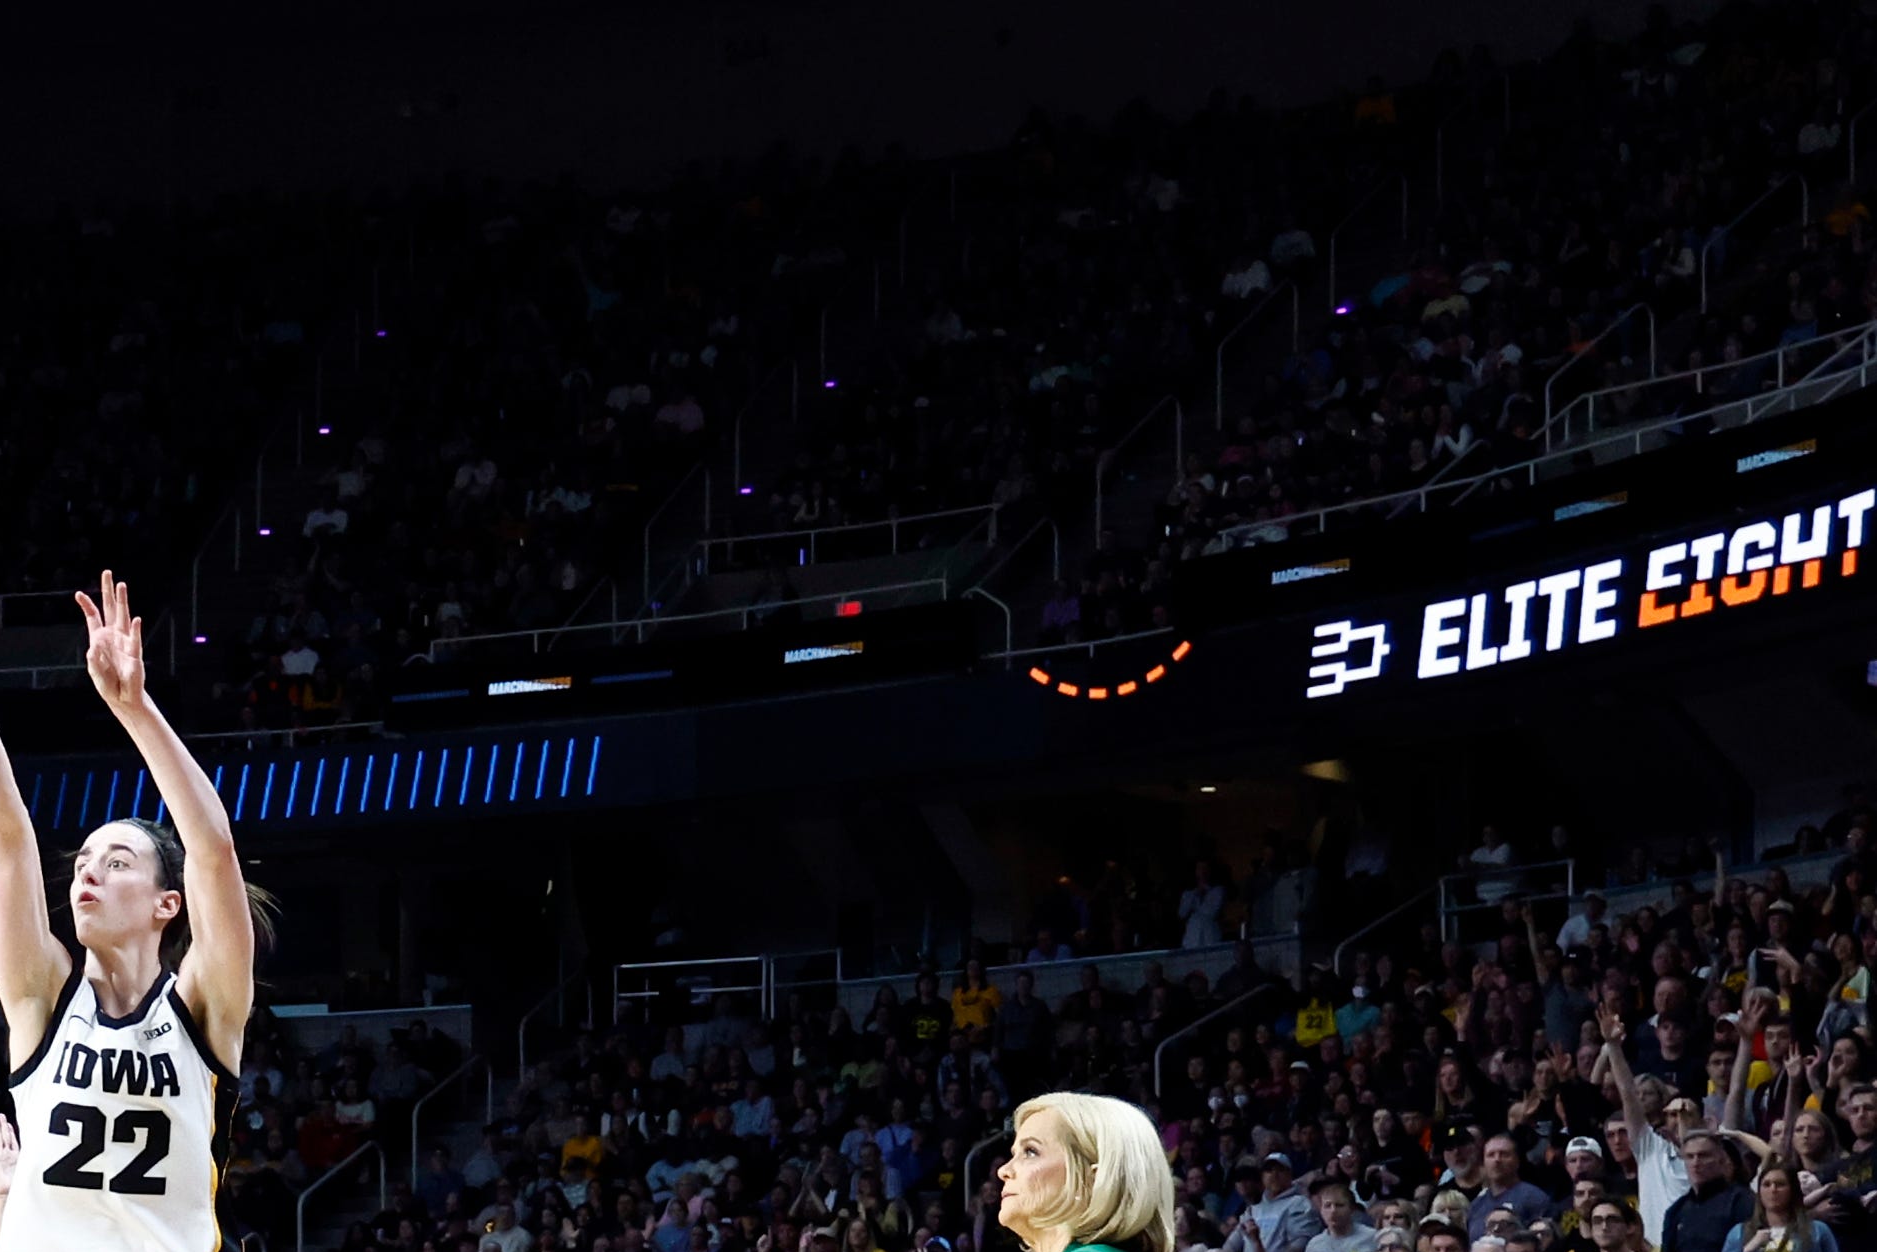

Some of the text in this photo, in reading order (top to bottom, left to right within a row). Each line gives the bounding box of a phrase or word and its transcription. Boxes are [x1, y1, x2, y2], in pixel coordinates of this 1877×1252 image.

[1418, 488, 1876, 679] ELITE EIGHT
[52, 1040, 181, 1098] IOWA
[42, 1101, 172, 1196] 22
